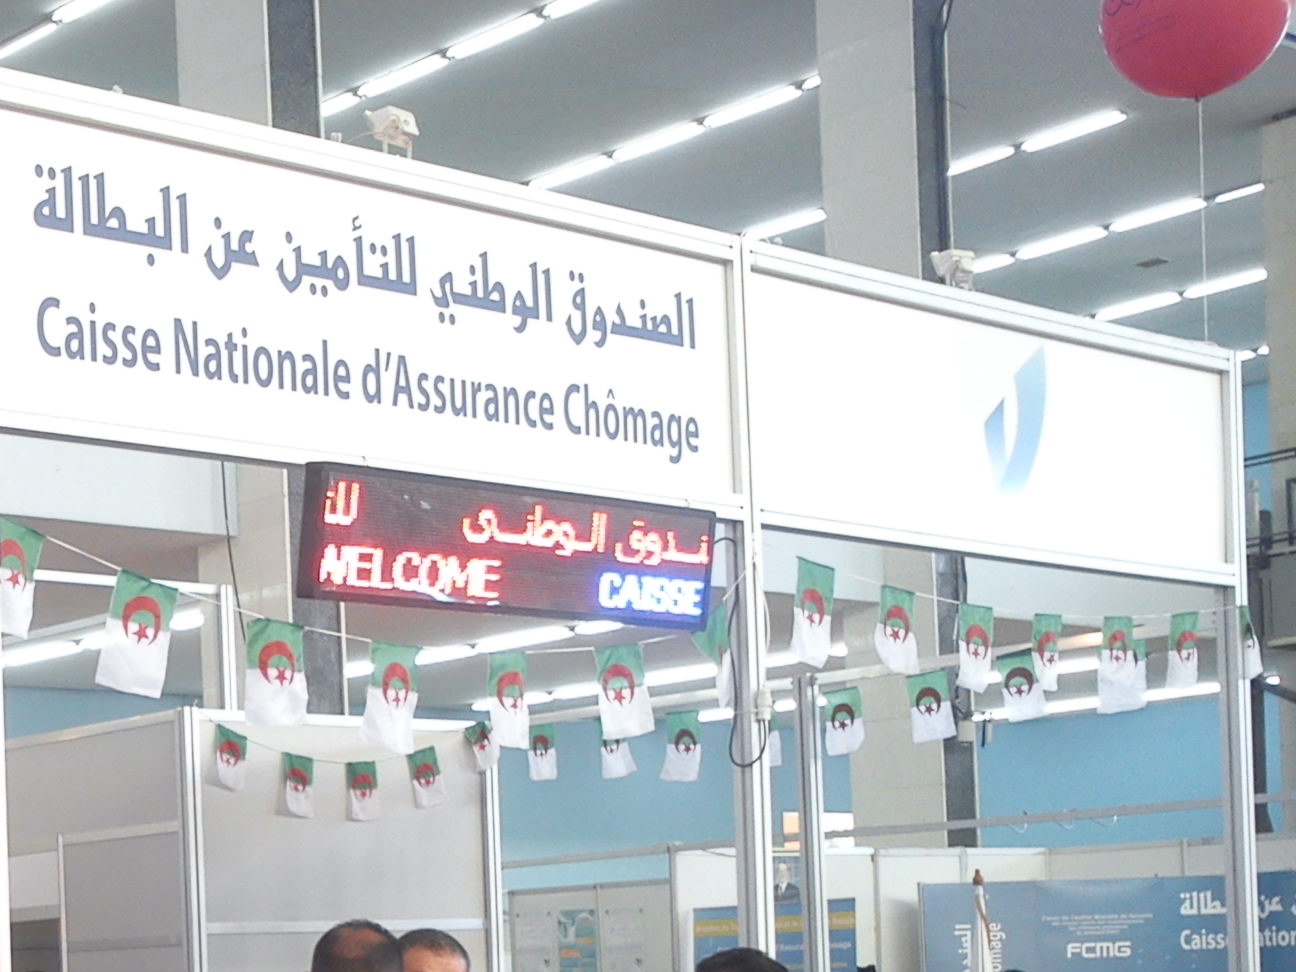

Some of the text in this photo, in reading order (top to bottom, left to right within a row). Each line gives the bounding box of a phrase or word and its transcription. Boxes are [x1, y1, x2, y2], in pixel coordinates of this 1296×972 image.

[33, 163, 696, 350] الصندوق الوطني للتأمين عن البطالة
[36, 296, 700, 465] Caisse Nationale d'Assurance Chômage
[615, 520, 709, 566] ندوق
[319, 544, 502, 598] WELCOME
[599, 572, 705, 616] CAISSE
[1179, 890, 1227, 916] طالة
[1067, 941, 1132, 959] FCMG
[1180, 928, 1228, 950] Caiss
